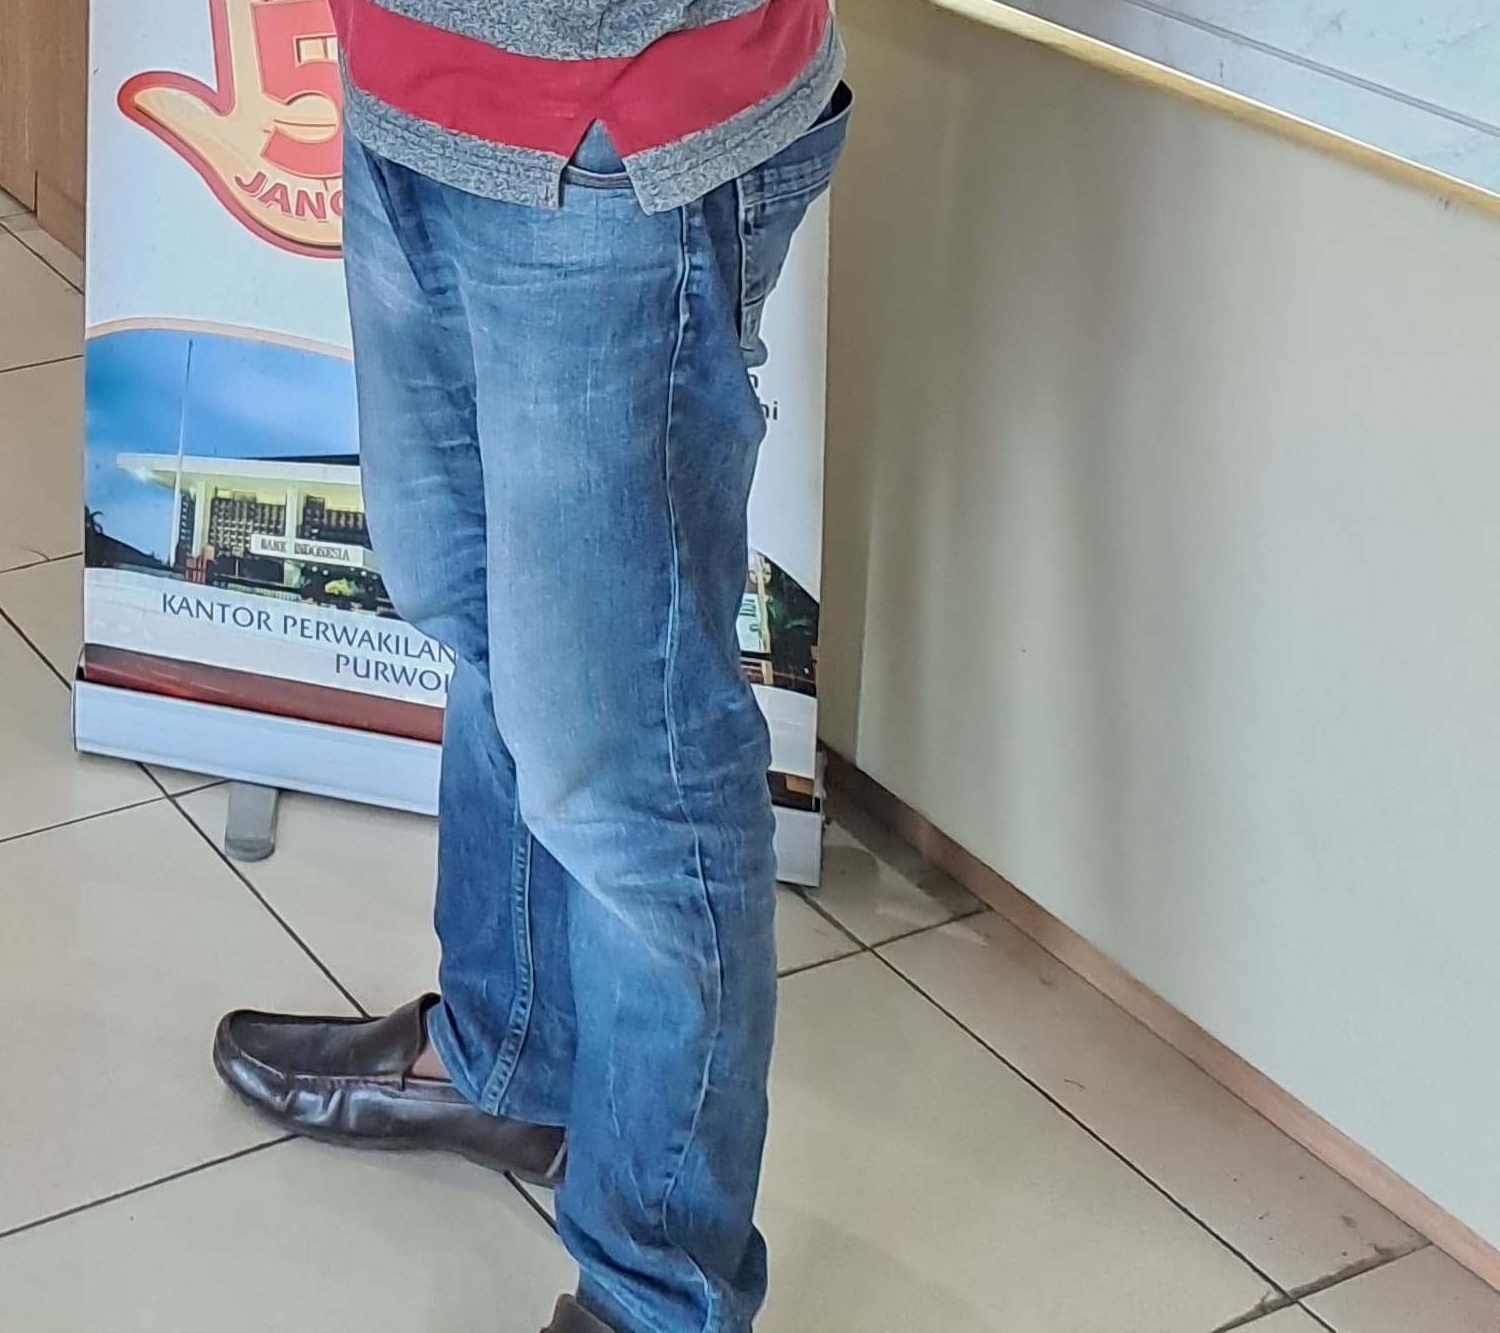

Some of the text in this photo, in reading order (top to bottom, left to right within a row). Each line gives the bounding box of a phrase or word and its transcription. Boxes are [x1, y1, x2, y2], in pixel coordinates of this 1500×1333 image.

[162, 592, 458, 666] KANTOR PERWAKILAN
[335, 653, 450, 694] PURWO
